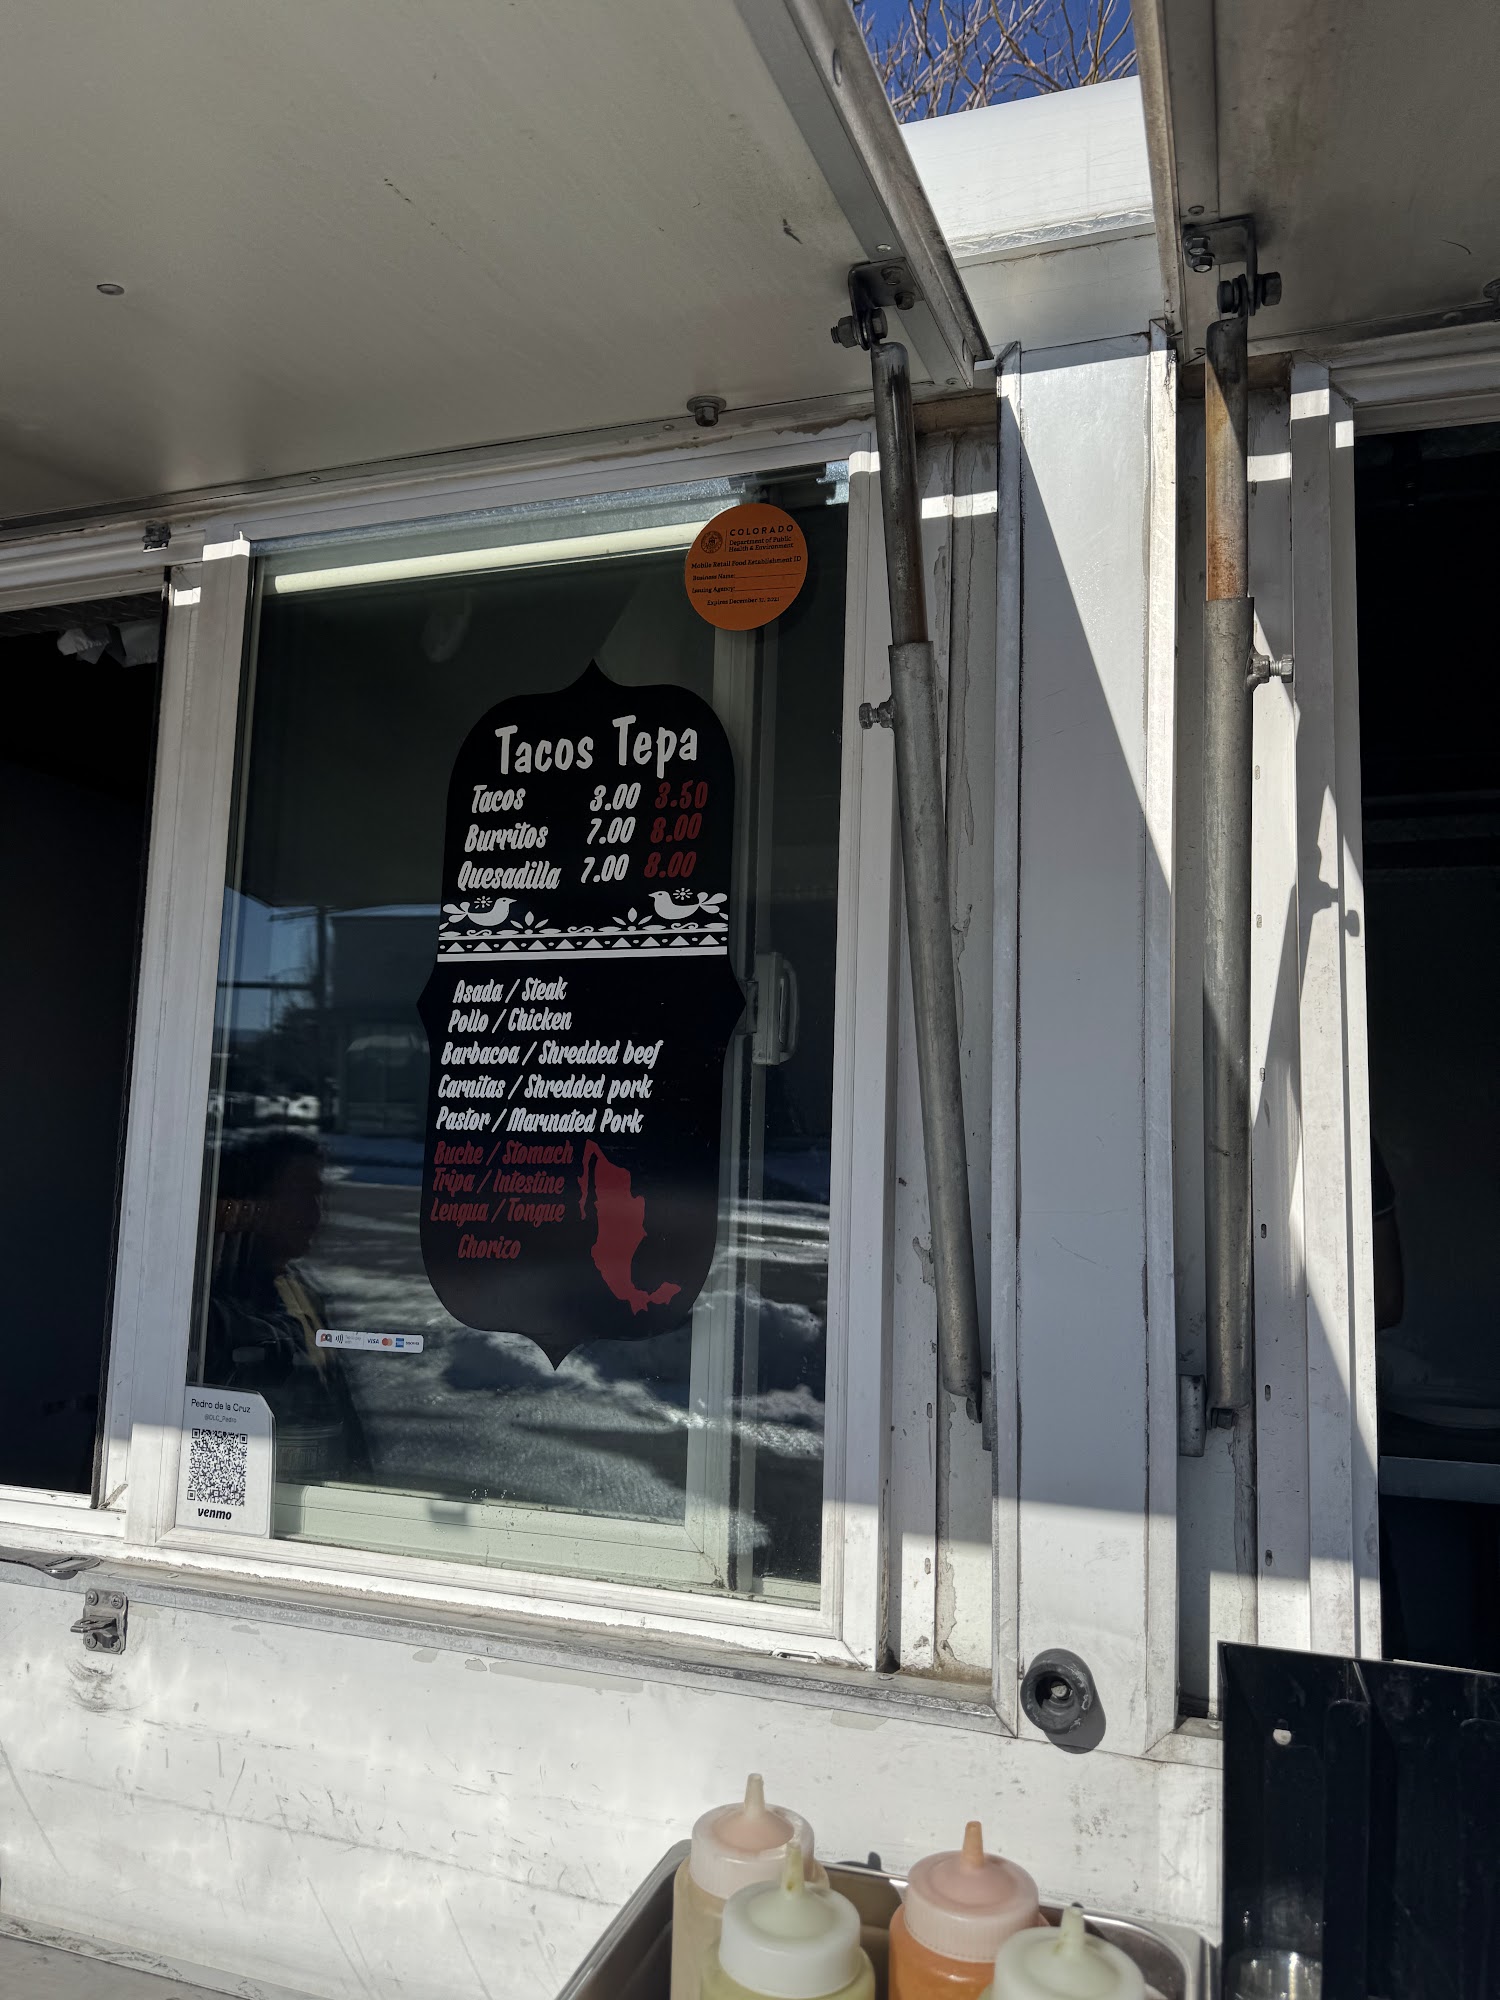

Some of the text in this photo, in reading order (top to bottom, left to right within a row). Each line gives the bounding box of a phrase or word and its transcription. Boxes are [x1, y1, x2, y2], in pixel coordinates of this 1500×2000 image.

[730, 525, 793, 536] COLORADO
[730, 538, 764, 546] Department
[747, 557, 792, 566] Establishment
[494, 715, 698, 778] Tacos Tepa
[471, 780, 709, 813] Tacos 3.00 3.50
[464, 813, 703, 853] Burritos 7.00 8.00
[457, 851, 697, 891] Quesadilla 7.00 8.00
[453, 976, 568, 1003] Asada / Steak
[447, 1007, 573, 1033] Pollo / Chicken
[441, 1040, 664, 1069] Barbacoa / Shredded beef
[438, 1074, 653, 1104] Carnitas / Shredded pork
[436, 1106, 491, 1131] Pastor
[492, 1108, 507, 1132] /
[600, 1108, 644, 1133] Pork
[433, 1140, 574, 1166] Buche / Stomach
[432, 1168, 565, 1196] Tripa / Intestine
[430, 1197, 566, 1228] Lengua / Tongue
[457, 1234, 521, 1259] Chorizo
[191, 1398, 213, 1409] Pedro
[214, 1401, 224, 1410] de
[233, 1403, 251, 1413] Cruz
[197, 1508, 232, 1520] venmo
